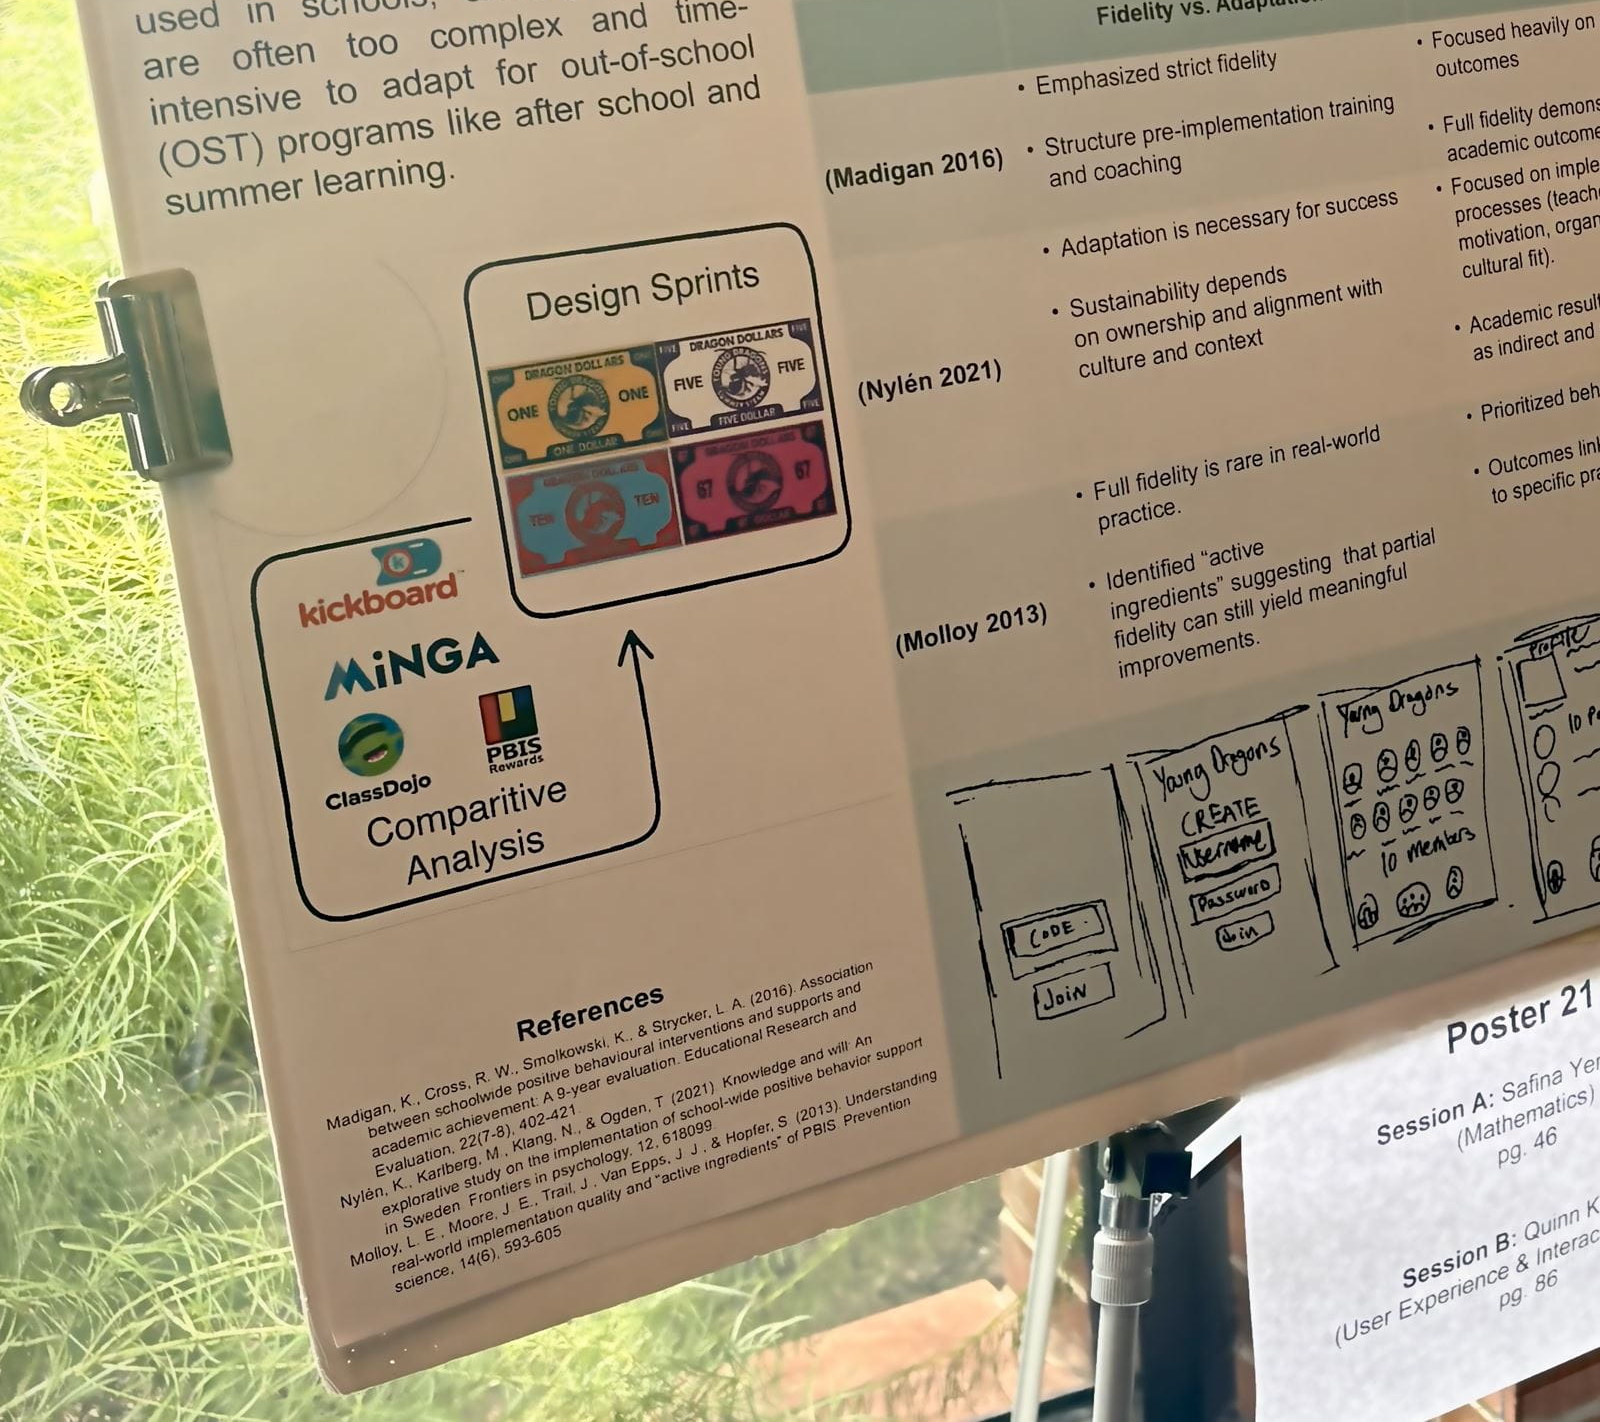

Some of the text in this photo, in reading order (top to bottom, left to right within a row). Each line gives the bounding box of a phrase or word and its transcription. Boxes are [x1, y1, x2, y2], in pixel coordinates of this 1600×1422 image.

[1097, 2, 1173, 25] Fidelity
[1180, 1, 1210, 16] vs.
[826, 148, 1002, 194] (Madigan 2016)
[527, 264, 759, 321] Design Sprints
[689, 328, 784, 352] DRAGON DOLLARS
[674, 376, 704, 392] FIVE
[778, 358, 805, 374] FIVE
[858, 359, 1001, 406] (Nylén 2021)
[507, 405, 539, 422] ONE
[618, 386, 649, 402] ONE
[298, 572, 458, 629] kickboard
[896, 602, 1046, 659] (Molloy 2013)
[486, 736, 543, 764] PBIS
[488, 752, 544, 774] Rewards
[325, 772, 433, 811] ClassDojo
[368, 782, 566, 847] Comparitive
[408, 829, 544, 885] Analysis
[517, 988, 664, 1041] References
[1448, 979, 1591, 1054] Poster 21
[382, 1037, 922, 1215] explorative study on the implementation of school-wide positive behavior support
[1378, 1104, 1464, 1145] Session
[1472, 1092, 1493, 1114] A:
[1503, 1070, 1562, 1102] Safina
[1458, 1084, 1594, 1152] (Mathematics)
[1534, 1126, 1557, 1149] 46
[1403, 1245, 1487, 1288] Session
[1496, 1232, 1516, 1253] B:
[1525, 1209, 1579, 1240] Quinn
[1336, 1311, 1392, 1349] (User
[1399, 1266, 1509, 1320] Experience
[1516, 1253, 1529, 1273] &
[1535, 1269, 1558, 1292] 86
